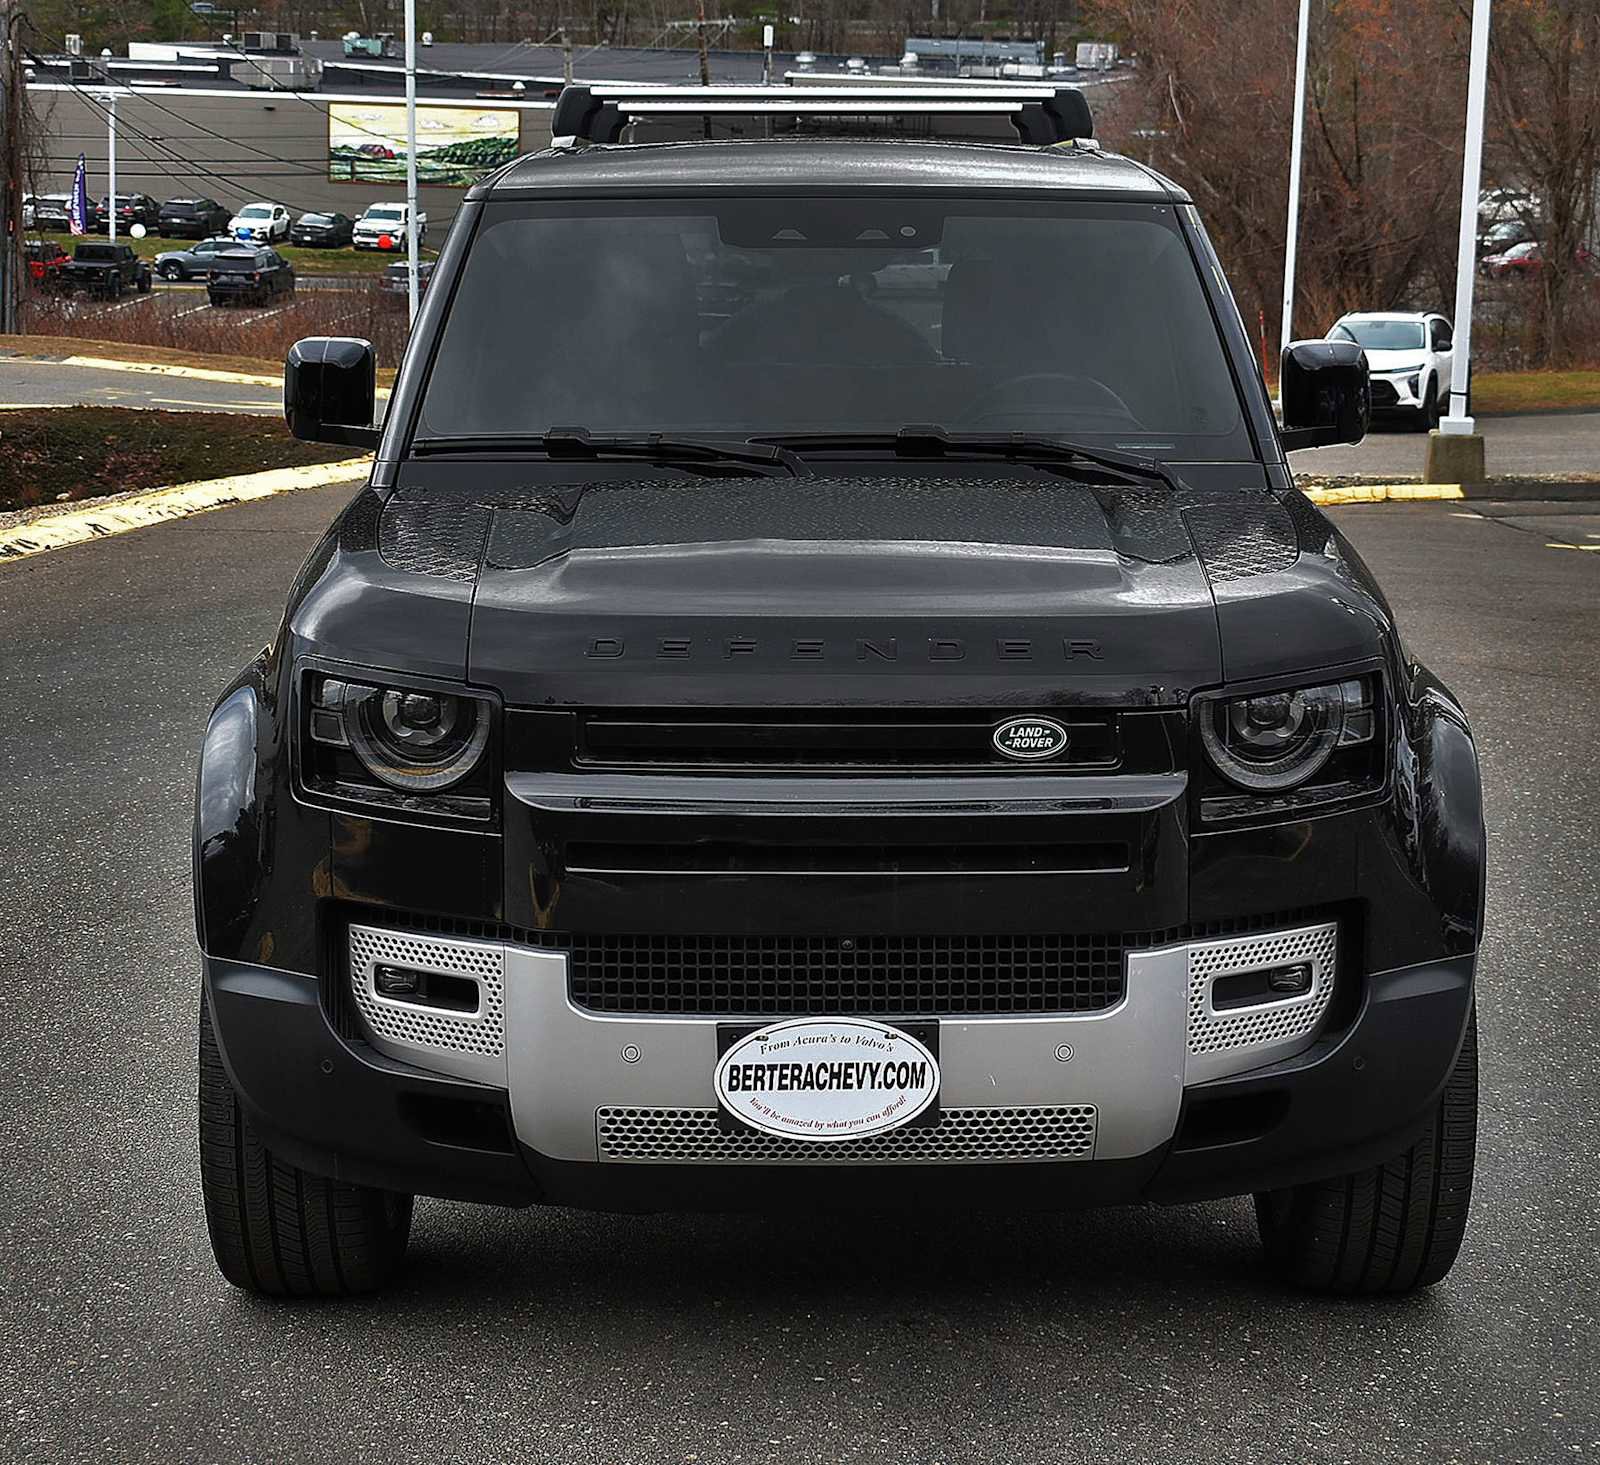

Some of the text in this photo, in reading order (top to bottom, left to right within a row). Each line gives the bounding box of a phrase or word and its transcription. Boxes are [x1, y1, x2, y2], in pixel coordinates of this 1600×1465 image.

[587, 638, 1105, 661] DEFENDER
[760, 1034, 895, 1055] From Acura's to Volvo's
[728, 1062, 926, 1092] BERTERACHEVY.COM
[750, 1094, 906, 1131] You'll be amazed by what you can afford!
